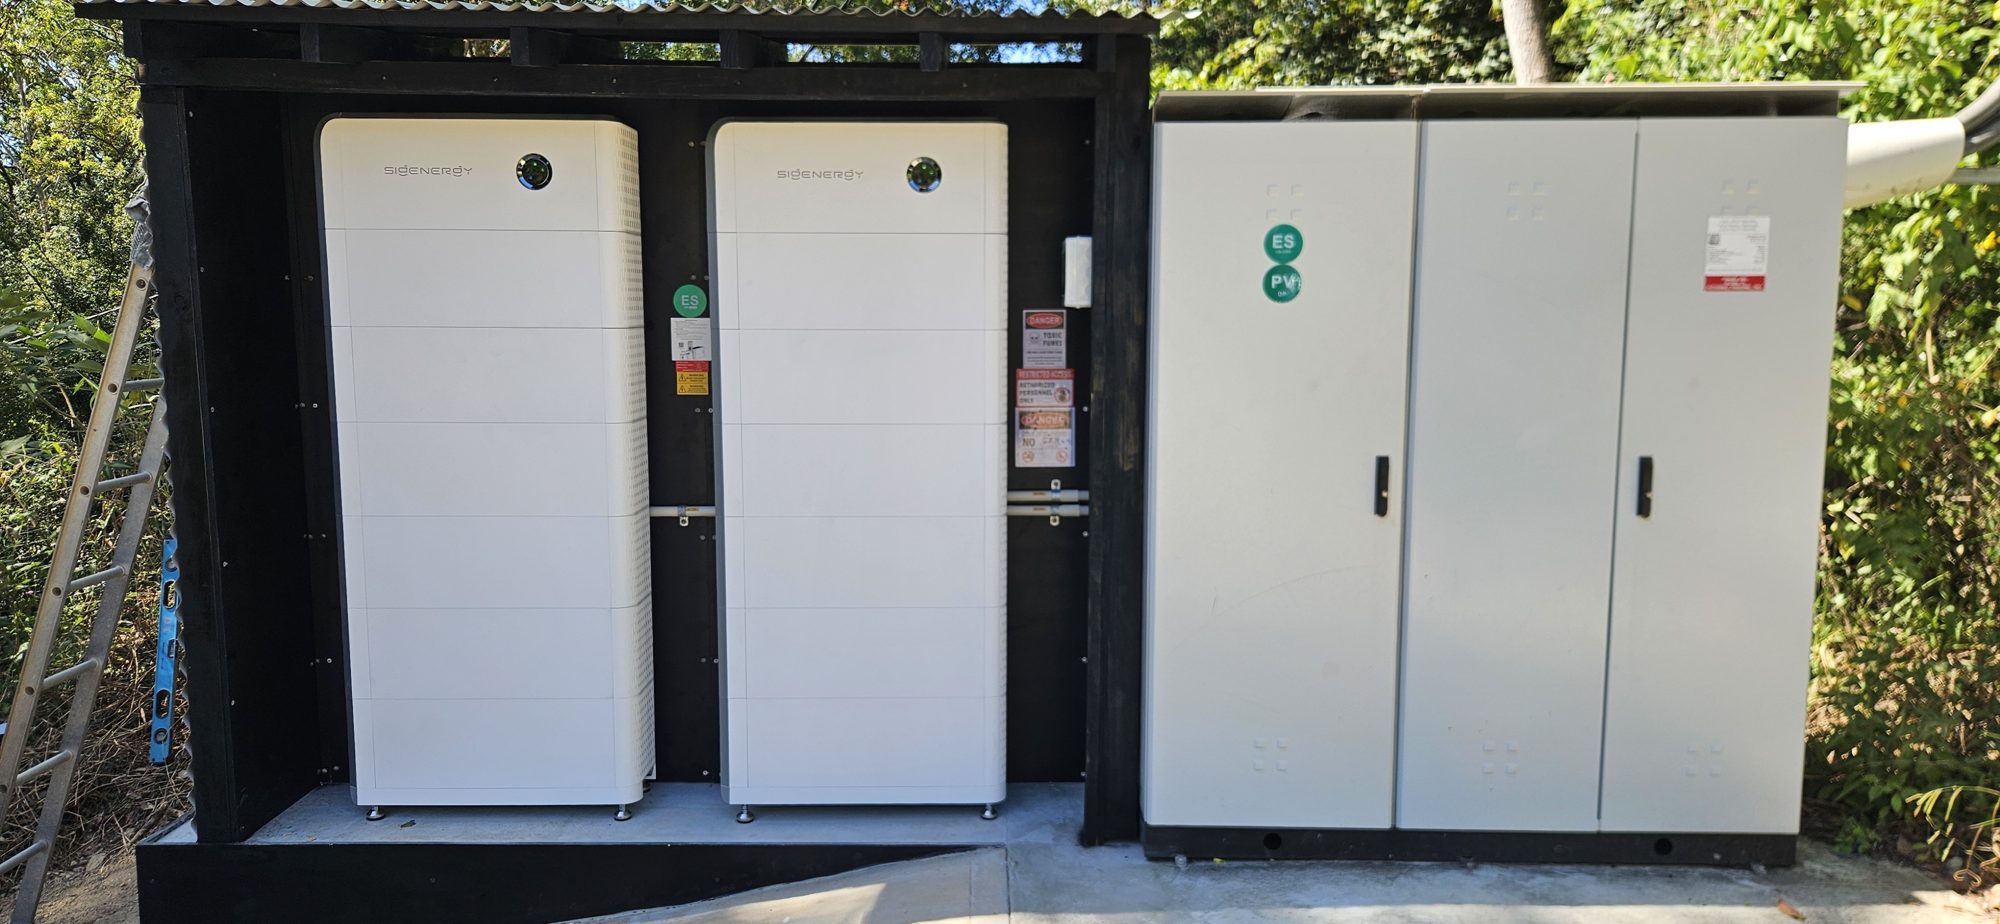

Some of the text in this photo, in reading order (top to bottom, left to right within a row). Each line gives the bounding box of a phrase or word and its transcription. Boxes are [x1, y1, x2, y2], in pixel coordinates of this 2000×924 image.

[1272, 234, 1295, 249] ES
[1271, 275, 1294, 289] PV
[681, 295, 699, 306] ES
[1029, 317, 1060, 325] DANGER
[1022, 437, 1036, 447] NO
